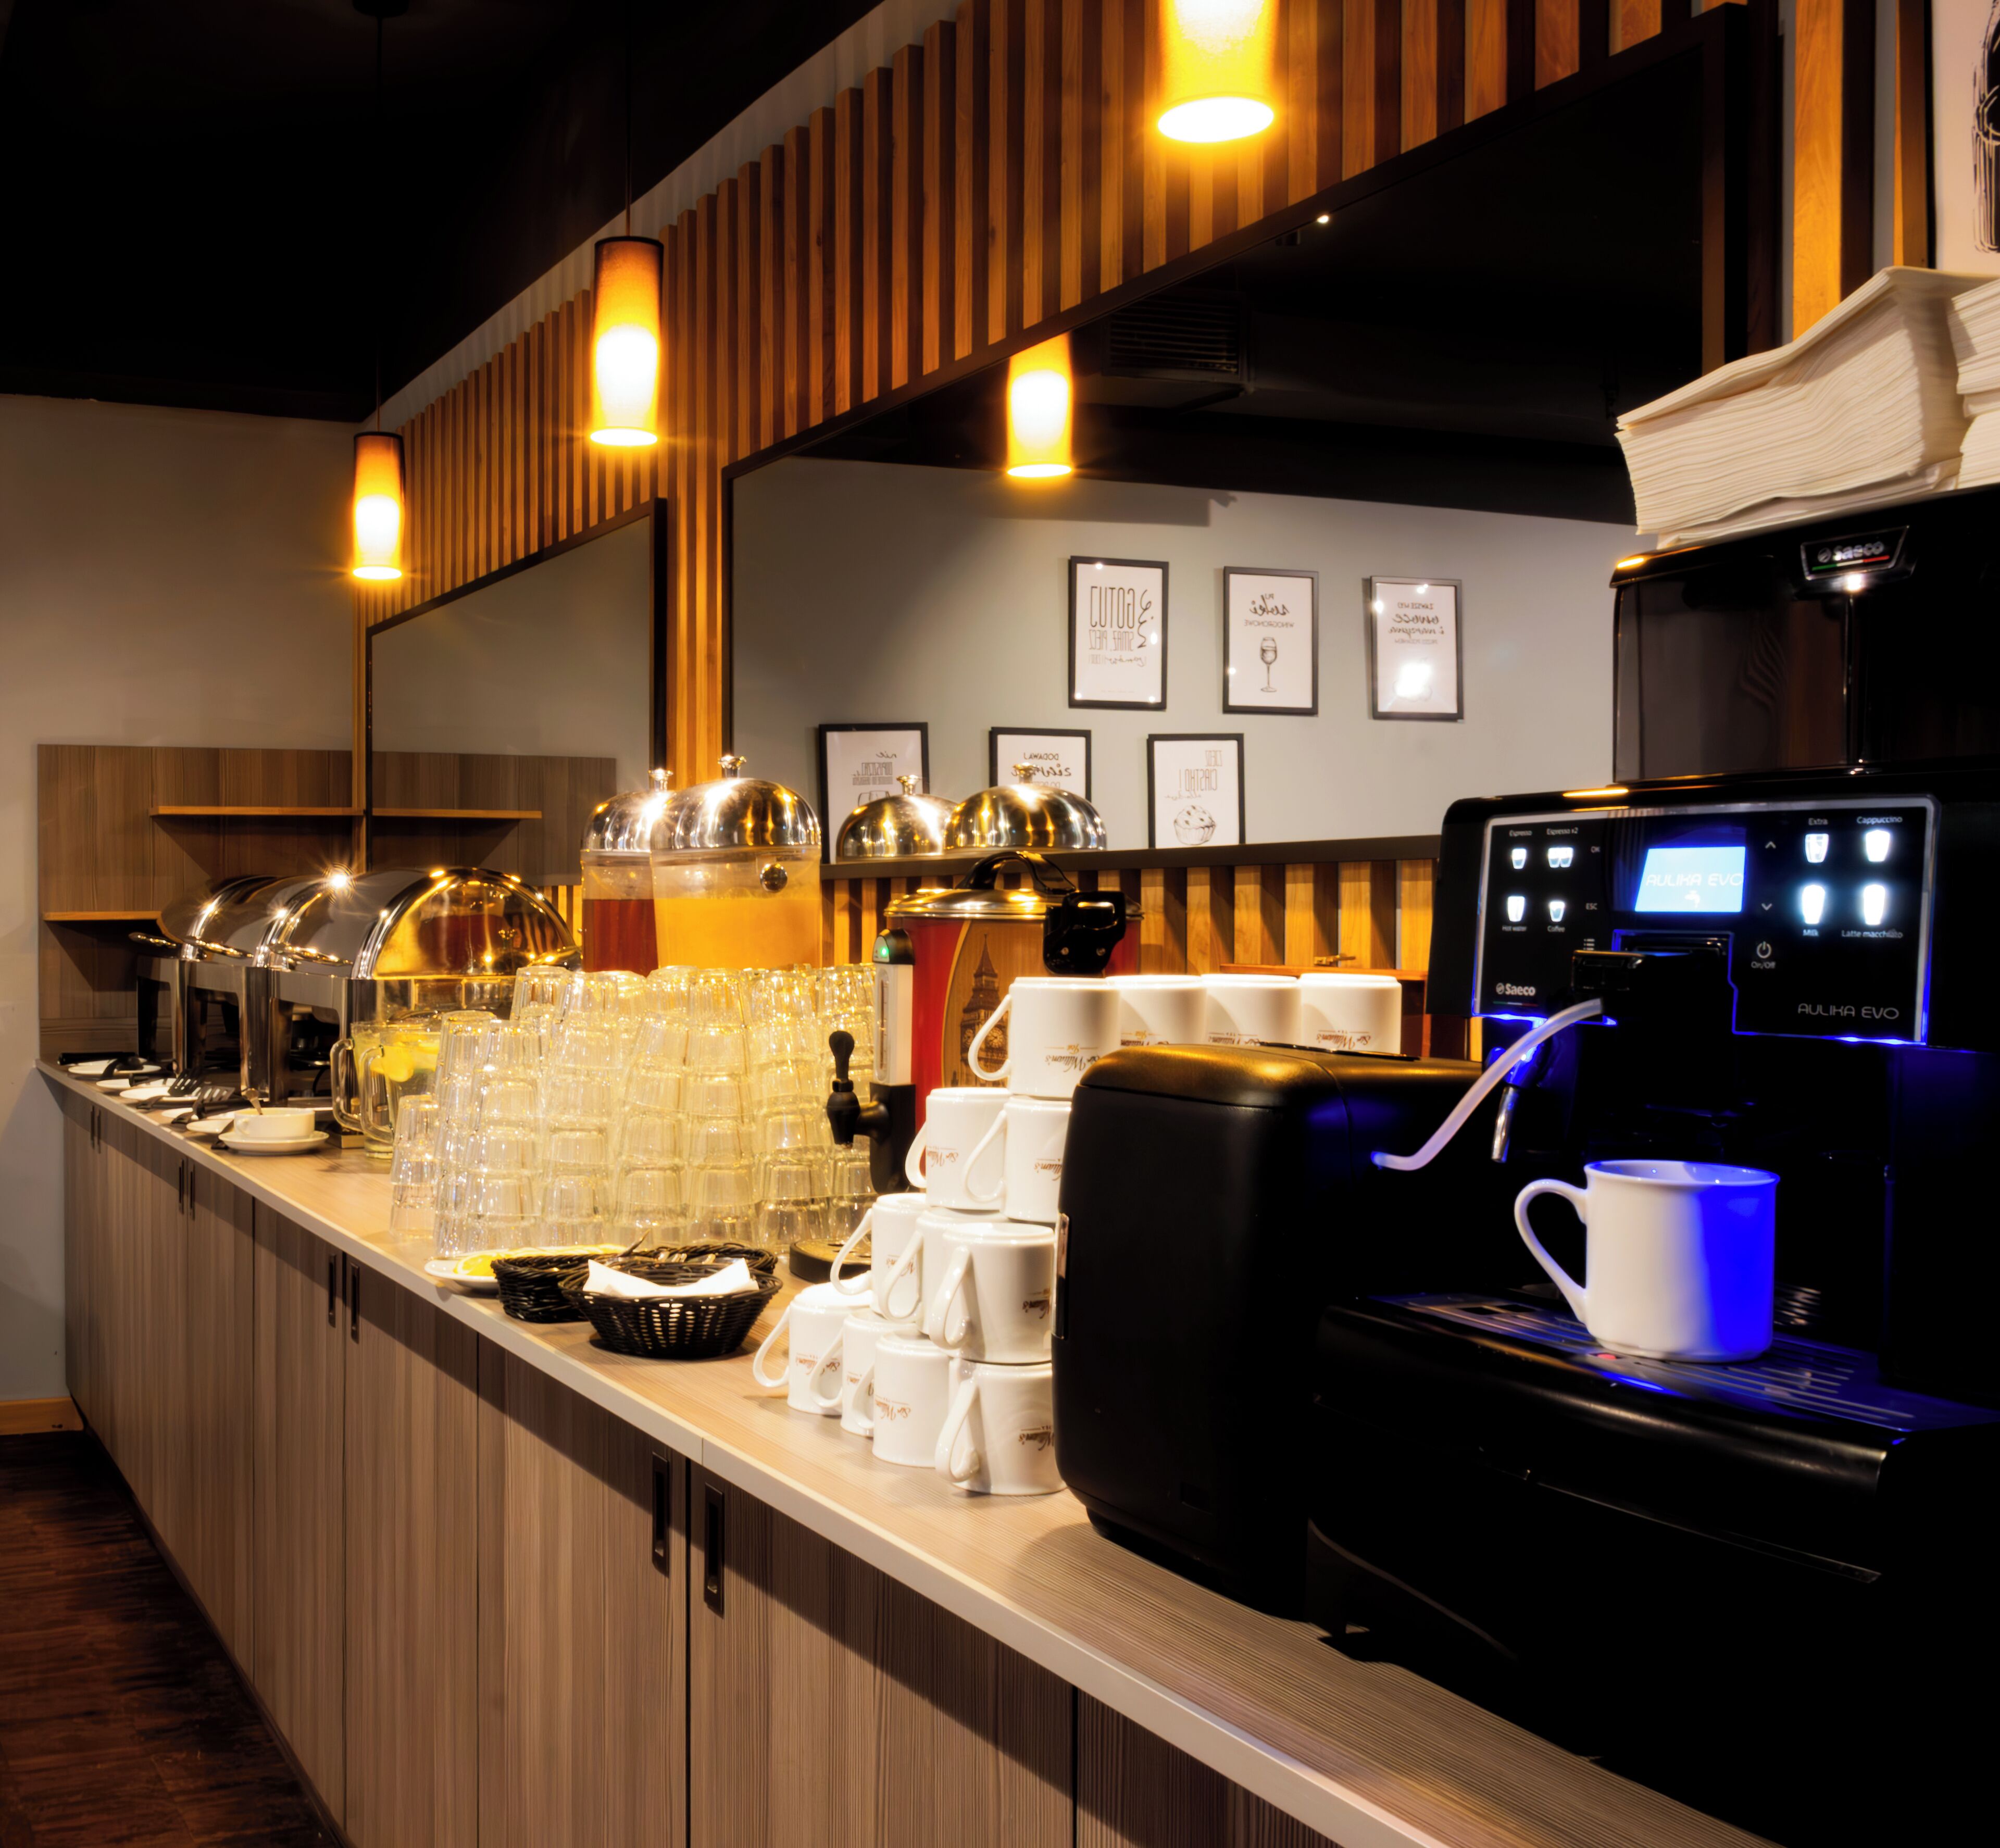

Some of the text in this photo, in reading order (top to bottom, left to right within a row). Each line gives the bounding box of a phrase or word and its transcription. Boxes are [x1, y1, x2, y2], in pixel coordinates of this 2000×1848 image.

[1808, 817, 1829, 826] Extra
[1856, 816, 1903, 825] Cappuccino
[1646, 873, 1744, 886] AULIKA EVO
[1841, 929, 1861, 938] Latte
[1505, 983, 1536, 996] Saeco
[1797, 1003, 1899, 1019] AULIKA EVO
[1316, 1033, 1371, 1051] Sir William's
[1045, 1055, 1086, 1072] William's
